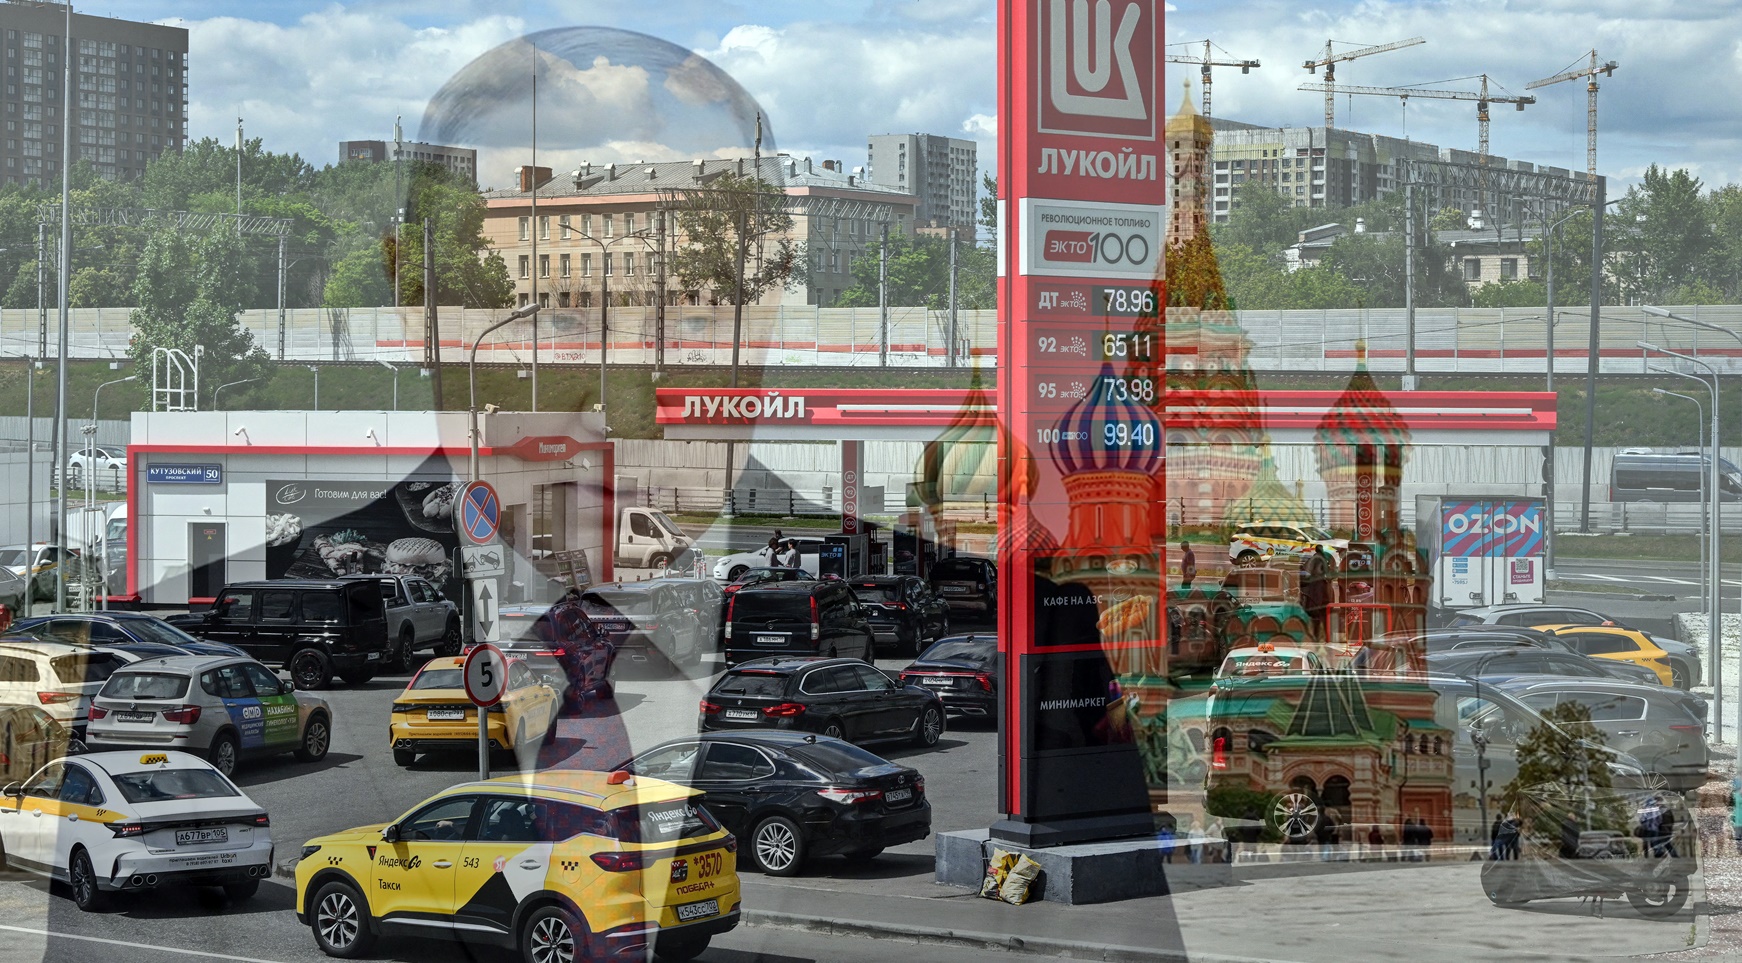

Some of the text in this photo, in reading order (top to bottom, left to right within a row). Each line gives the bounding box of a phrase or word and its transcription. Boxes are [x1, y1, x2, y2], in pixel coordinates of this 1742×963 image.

[1037, 147, 1157, 181] ЛУКОЙЛ
[1041, 213, 1151, 228] РЕВОЛЮЦИОННОЕ ТОПЛИВО
[1038, 291, 1059, 310] ДТ
[1104, 289, 1154, 312] 78.96
[1038, 336, 1057, 353] 92
[1038, 382, 1057, 399] 95
[681, 391, 805, 418] ЛУКОЙЛ
[1037, 428, 1060, 444] 100
[1104, 423, 1154, 446] 99.40
[150, 467, 202, 475] КУТУЗОВСКИЙ
[205, 469, 218, 479] 50
[314, 488, 387, 500] Готовим для вас!
[1449, 513, 1540, 534] OZON
[1043, 595, 1103, 606] КАФЕ НА АЗС
[481, 661, 492, 687] 5
[1040, 697, 1106, 710] МИНИМАРКЕТ
[648, 803, 698, 822] Яндекс Go
[378, 855, 422, 869] Яндекс Go
[463, 857, 480, 868] 543
[378, 878, 401, 890] Такси
